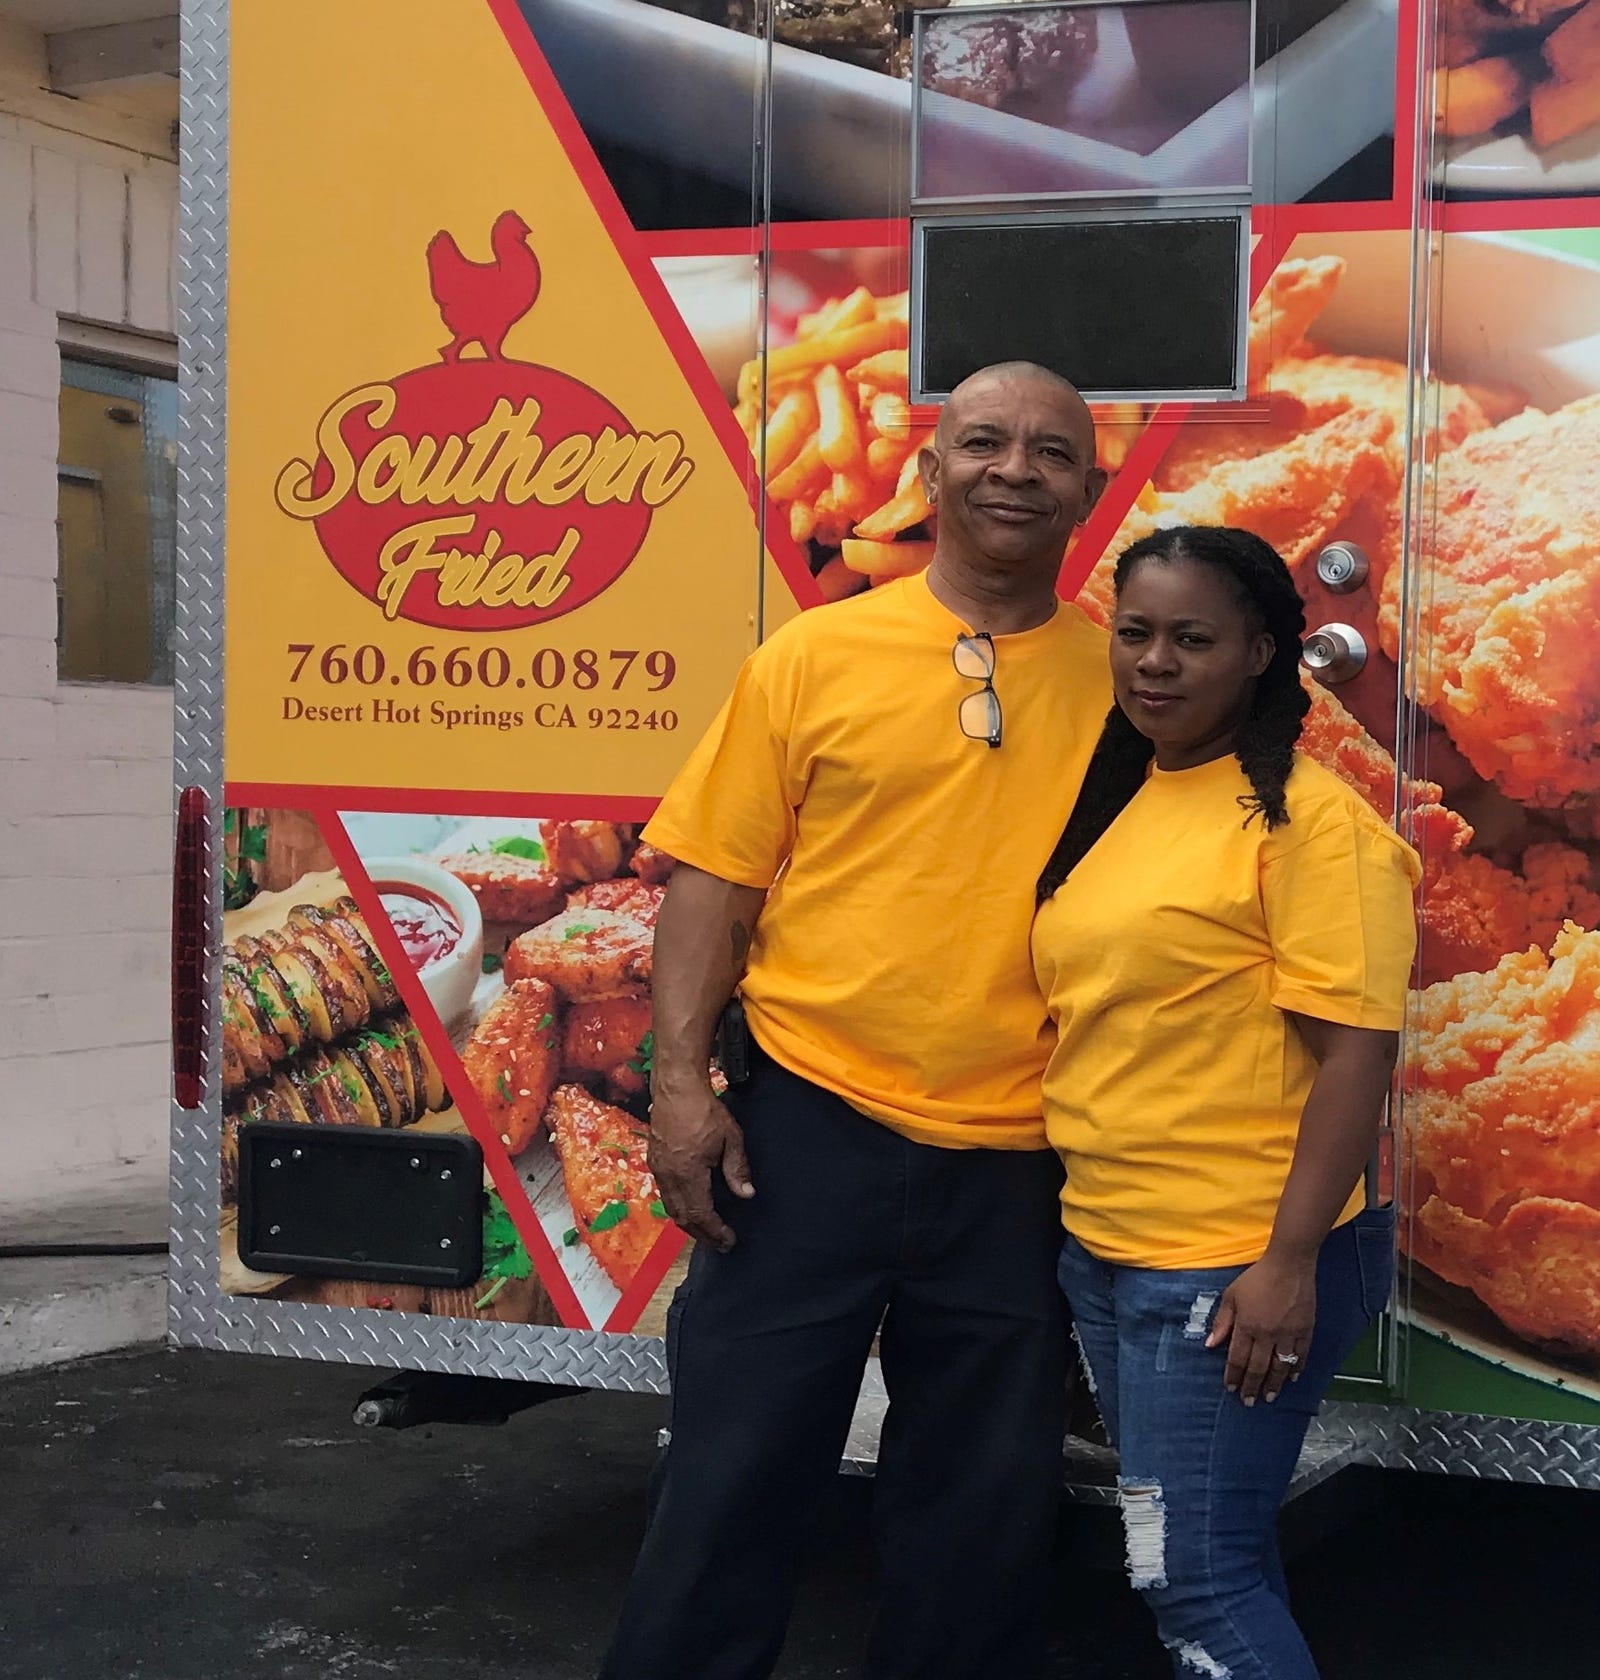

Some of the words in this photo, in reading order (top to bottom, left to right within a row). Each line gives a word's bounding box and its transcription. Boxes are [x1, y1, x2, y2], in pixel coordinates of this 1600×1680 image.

[274, 381, 696, 520] Southern
[376, 511, 582, 621] Fried
[286, 643, 677, 693] 760.660.0879
[281, 696, 363, 723] Desert
[371, 699, 421, 725] Hot
[429, 700, 524, 732] Springs
[534, 703, 577, 729] CA
[587, 708, 679, 732] 92240
